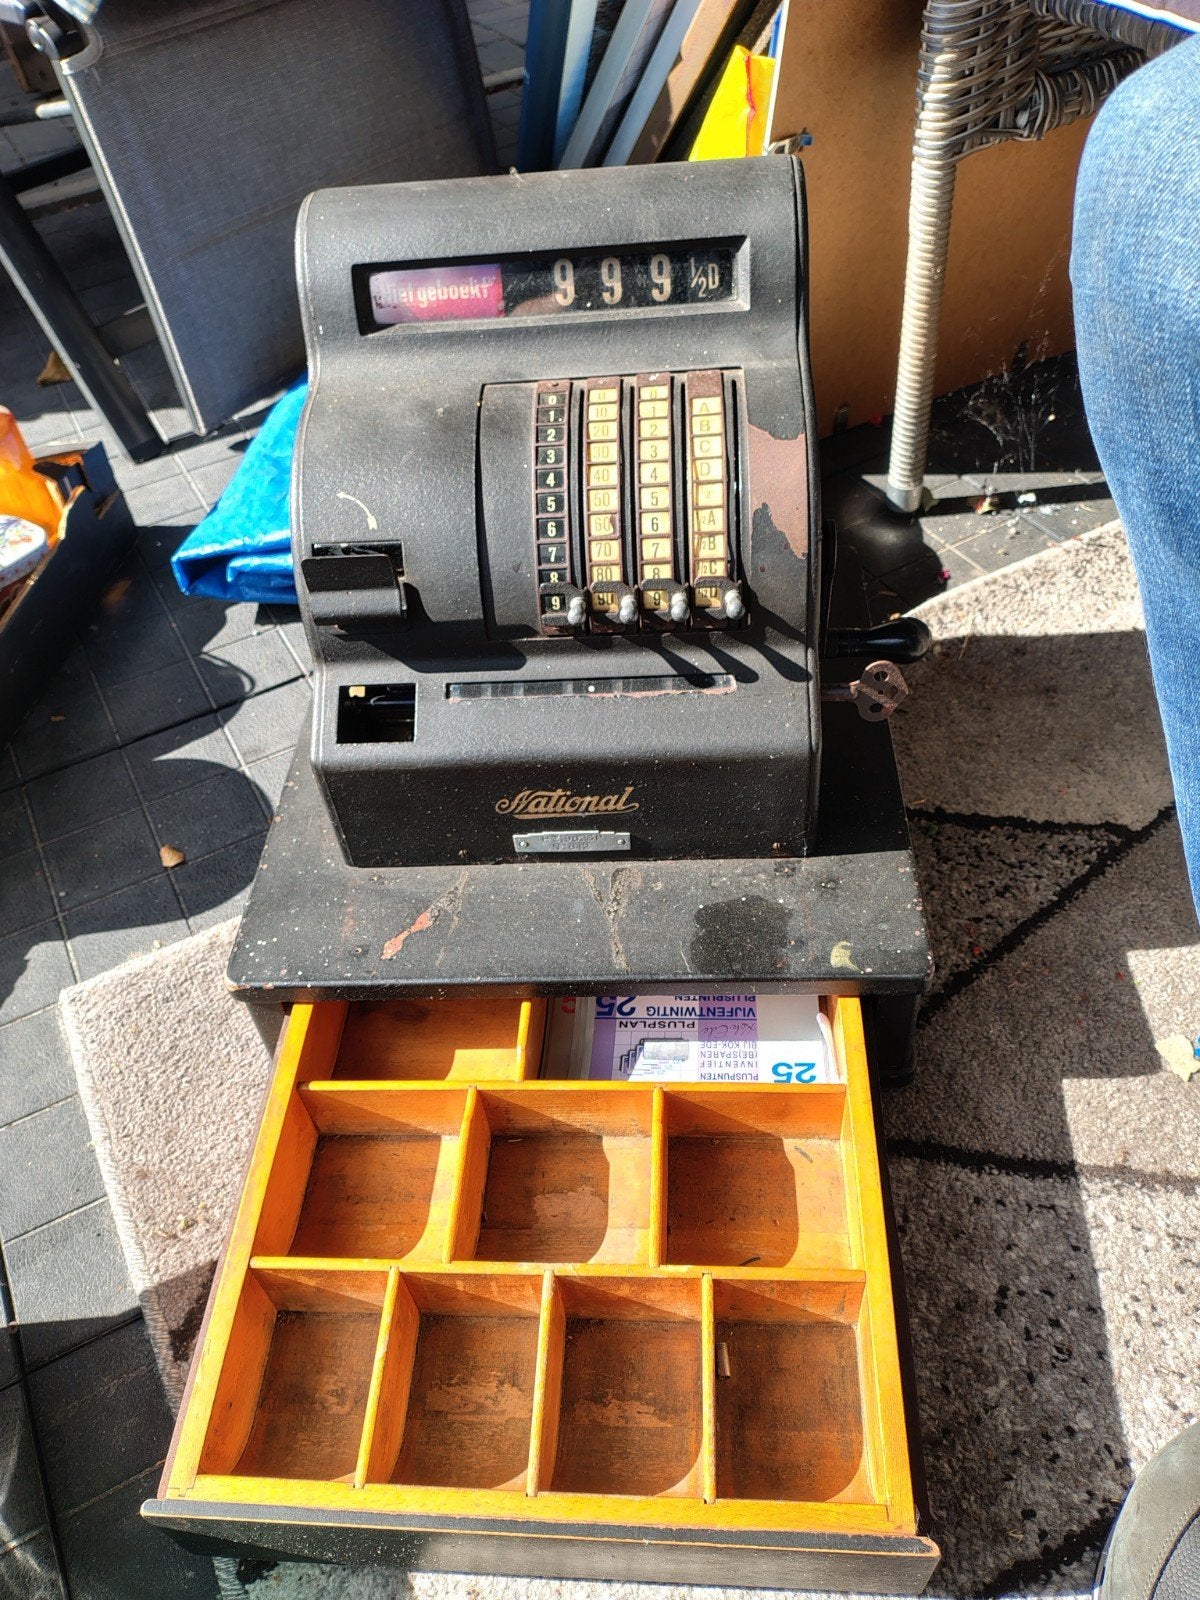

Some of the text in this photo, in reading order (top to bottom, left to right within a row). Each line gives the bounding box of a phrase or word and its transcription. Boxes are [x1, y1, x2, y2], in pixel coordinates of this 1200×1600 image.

[554, 258, 575, 307] 9
[601, 256, 623, 305] 9
[650, 253, 672, 302] 9
[417, 276, 491, 308] geboekt
[548, 395, 557, 405] 0
[598, 392, 606, 400] 0
[650, 390, 657, 400] 0
[595, 405, 608, 418] 10
[651, 406, 656, 418] 1
[699, 402, 711, 413] A
[549, 411, 555, 422] 1
[593, 425, 609, 438] 20
[650, 424, 658, 437] 2
[700, 419, 711, 432] B
[547, 428, 556, 441] 2
[593, 446, 609, 459] 30
[650, 445, 658, 459] 3
[699, 440, 711, 454] C
[546, 449, 556, 463] 3
[593, 468, 609, 482] 40
[650, 467, 658, 482] 4
[700, 463, 711, 476] D
[546, 472, 556, 487] 4
[547, 496, 556, 511] 5
[594, 493, 610, 507] 50
[650, 493, 659, 507] 5
[547, 521, 557, 537] 6
[595, 518, 611, 532] 60
[651, 517, 659, 532] 6
[548, 546, 557, 562] 7
[596, 543, 612, 558] 70
[651, 543, 660, 557] 7
[596, 568, 613, 582] 80
[551, 596, 560, 610] 9
[653, 591, 661, 606] 9
[495, 786, 640, 820] National
[595, 996, 637, 1017] 25
[646, 1006, 756, 1018] VIJFENTWINTIG
[618, 1020, 695, 1029] PLUSPLAN
[700, 1041, 757, 1049] BIJ KOK-EDE
[700, 1050, 758, 1059] (BE)SPAREN
[700, 1060, 758, 1068] INVENTIEF
[700, 1073, 759, 1081] PLUSPUNTEN
[771, 1062, 817, 1083] 25
